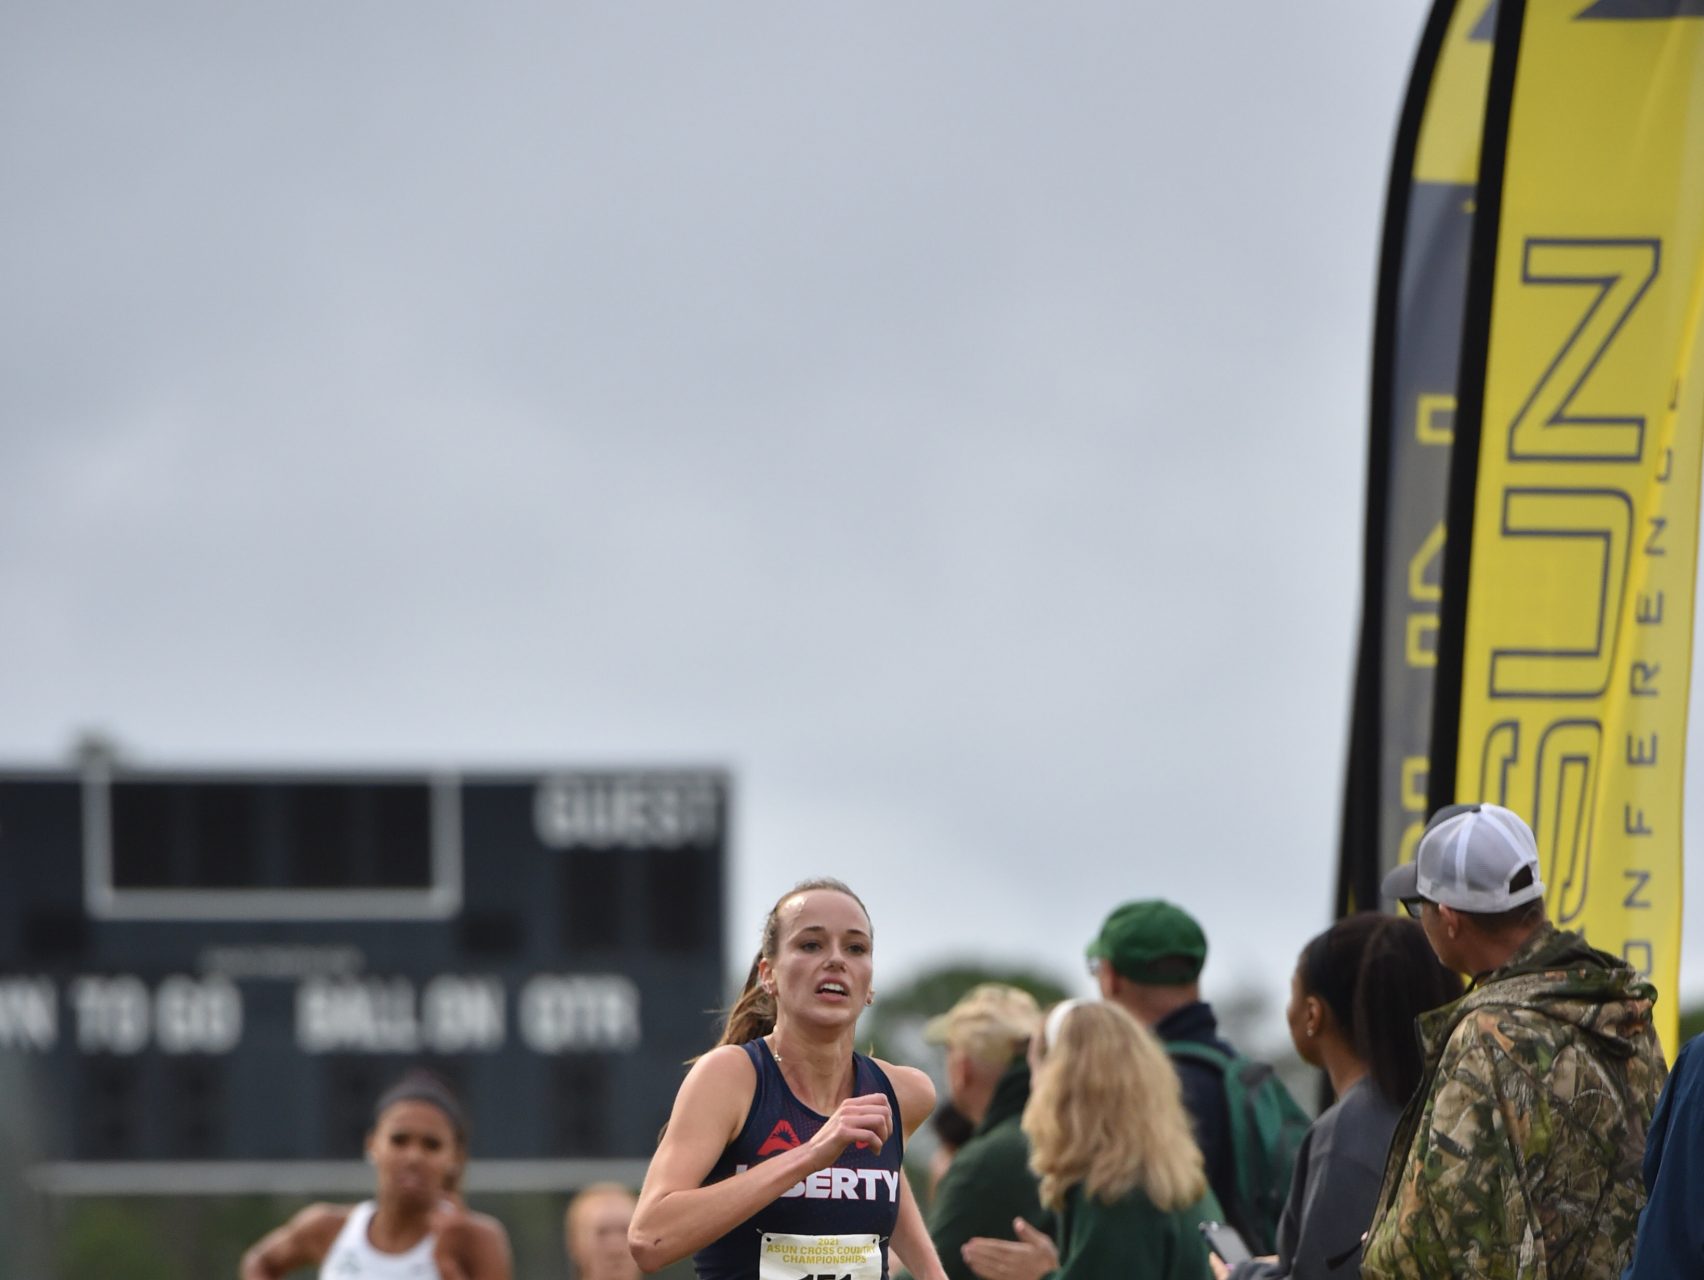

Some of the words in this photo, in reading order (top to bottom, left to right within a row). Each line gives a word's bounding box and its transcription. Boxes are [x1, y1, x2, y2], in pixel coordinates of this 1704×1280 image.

[1478, 236, 1662, 940] SUN
[536, 778, 714, 847] GUEST
[299, 979, 421, 1052] BALL
[424, 979, 503, 1052] ON
[736, 1164, 899, 1202] ERTY
[766, 1244, 797, 1254] ASUN
[800, 1246, 834, 1255] CROSS
[837, 1244, 875, 1255] COUNTRY
[782, 1254, 867, 1264] CHAMPIONSHIPS
